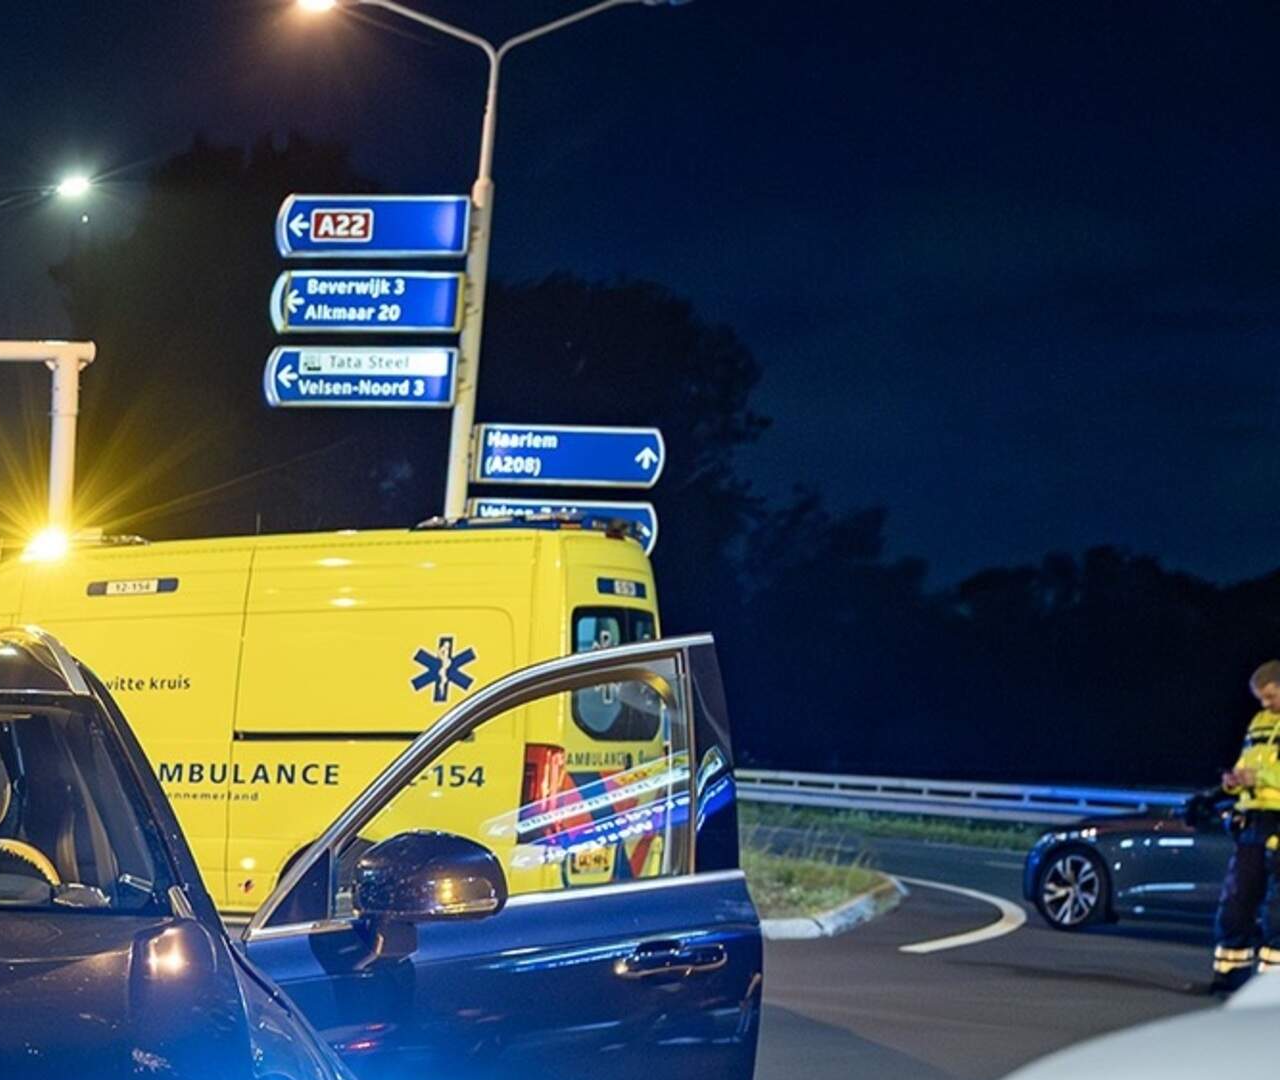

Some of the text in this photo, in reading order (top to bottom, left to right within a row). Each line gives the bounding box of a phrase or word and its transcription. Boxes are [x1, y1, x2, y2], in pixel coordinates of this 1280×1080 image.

[317, 214, 366, 237] A22
[306, 278, 406, 299] Beverwijk 3
[304, 304, 401, 321] Alkmaar 20
[329, 355, 410, 369] Tata Steel
[298, 379, 425, 397] Velsen-Noord 3
[487, 431, 558, 449] Haarlem
[485, 455, 542, 477] (A208)
[149, 674, 191, 690] kruis
[159, 762, 340, 785] MBULANCE
